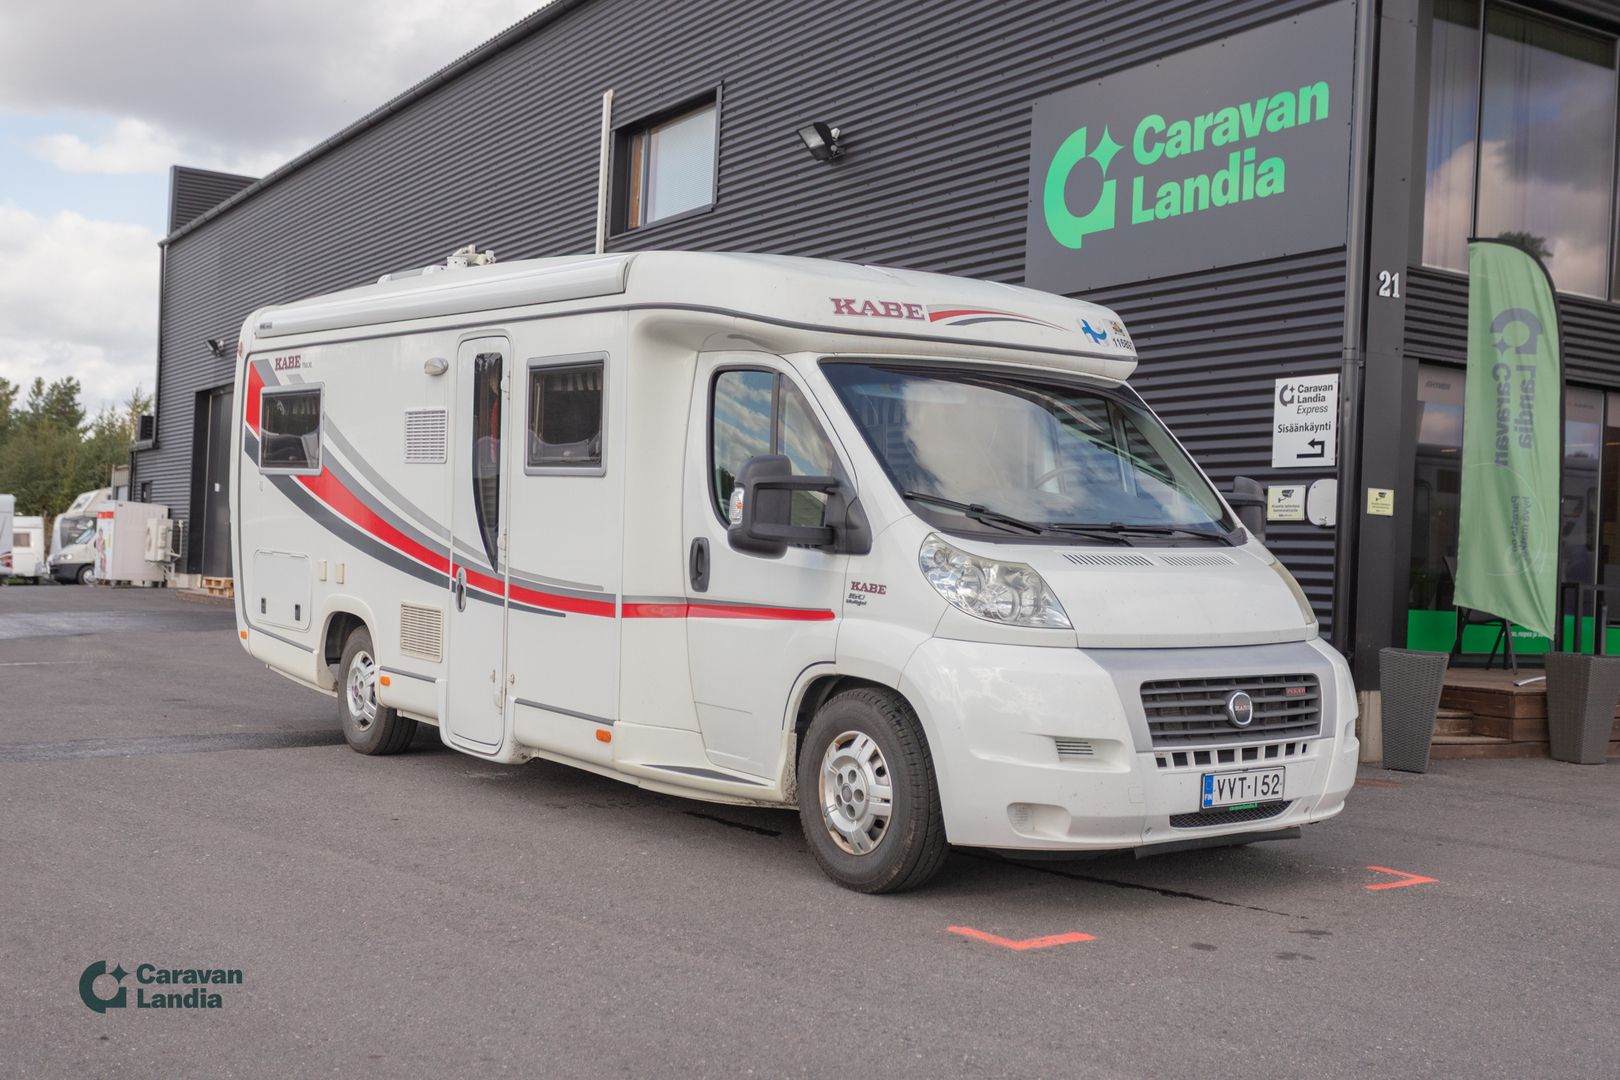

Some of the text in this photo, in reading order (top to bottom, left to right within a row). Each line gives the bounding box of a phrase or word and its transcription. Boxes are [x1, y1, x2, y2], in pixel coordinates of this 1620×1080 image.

[1133, 81, 1329, 165] Caravan
[1131, 147, 1285, 225] Landia
[1379, 270, 1400, 298] 21
[830, 297, 927, 321] KABE
[275, 355, 302, 371] KABE
[1297, 384, 1333, 393] Caravan
[1297, 393, 1326, 404] Landia
[1296, 405, 1329, 416] Express
[1277, 421, 1332, 434] Sisäänkäynti
[850, 581, 887, 595] KABE
[1217, 774, 1280, 800] VVT-152
